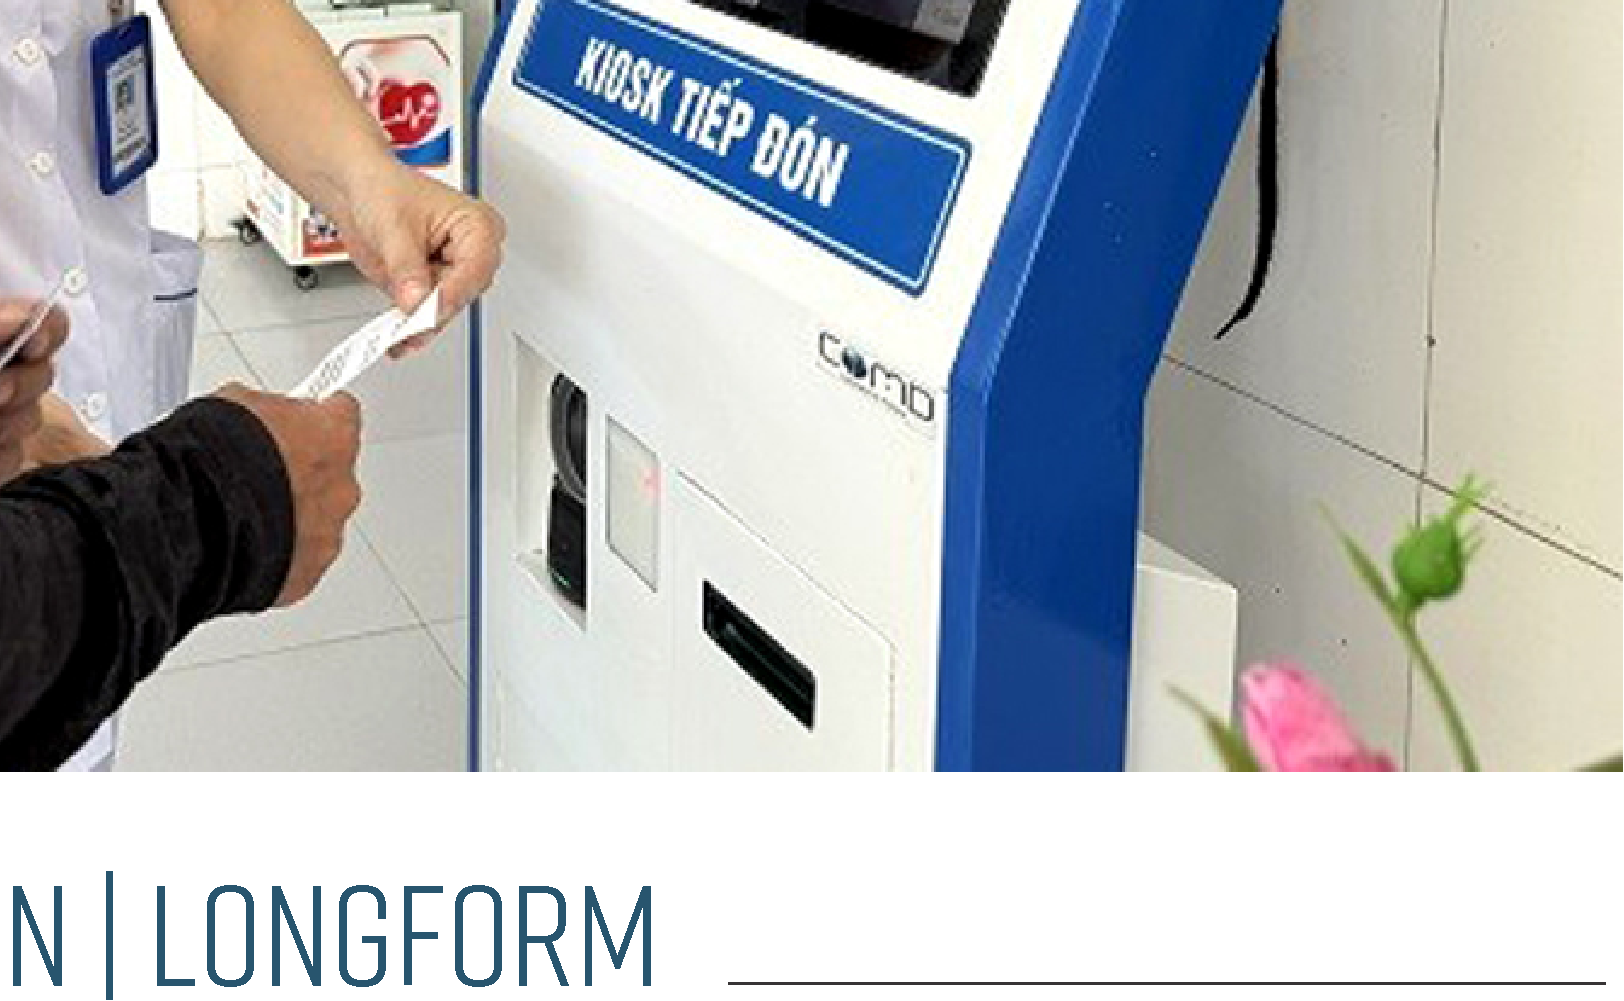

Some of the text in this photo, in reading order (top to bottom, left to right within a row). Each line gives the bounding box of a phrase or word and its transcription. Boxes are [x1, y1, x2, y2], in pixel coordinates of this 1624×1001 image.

[574, 36, 850, 209] KIOSK TIẾP ĐÓN
